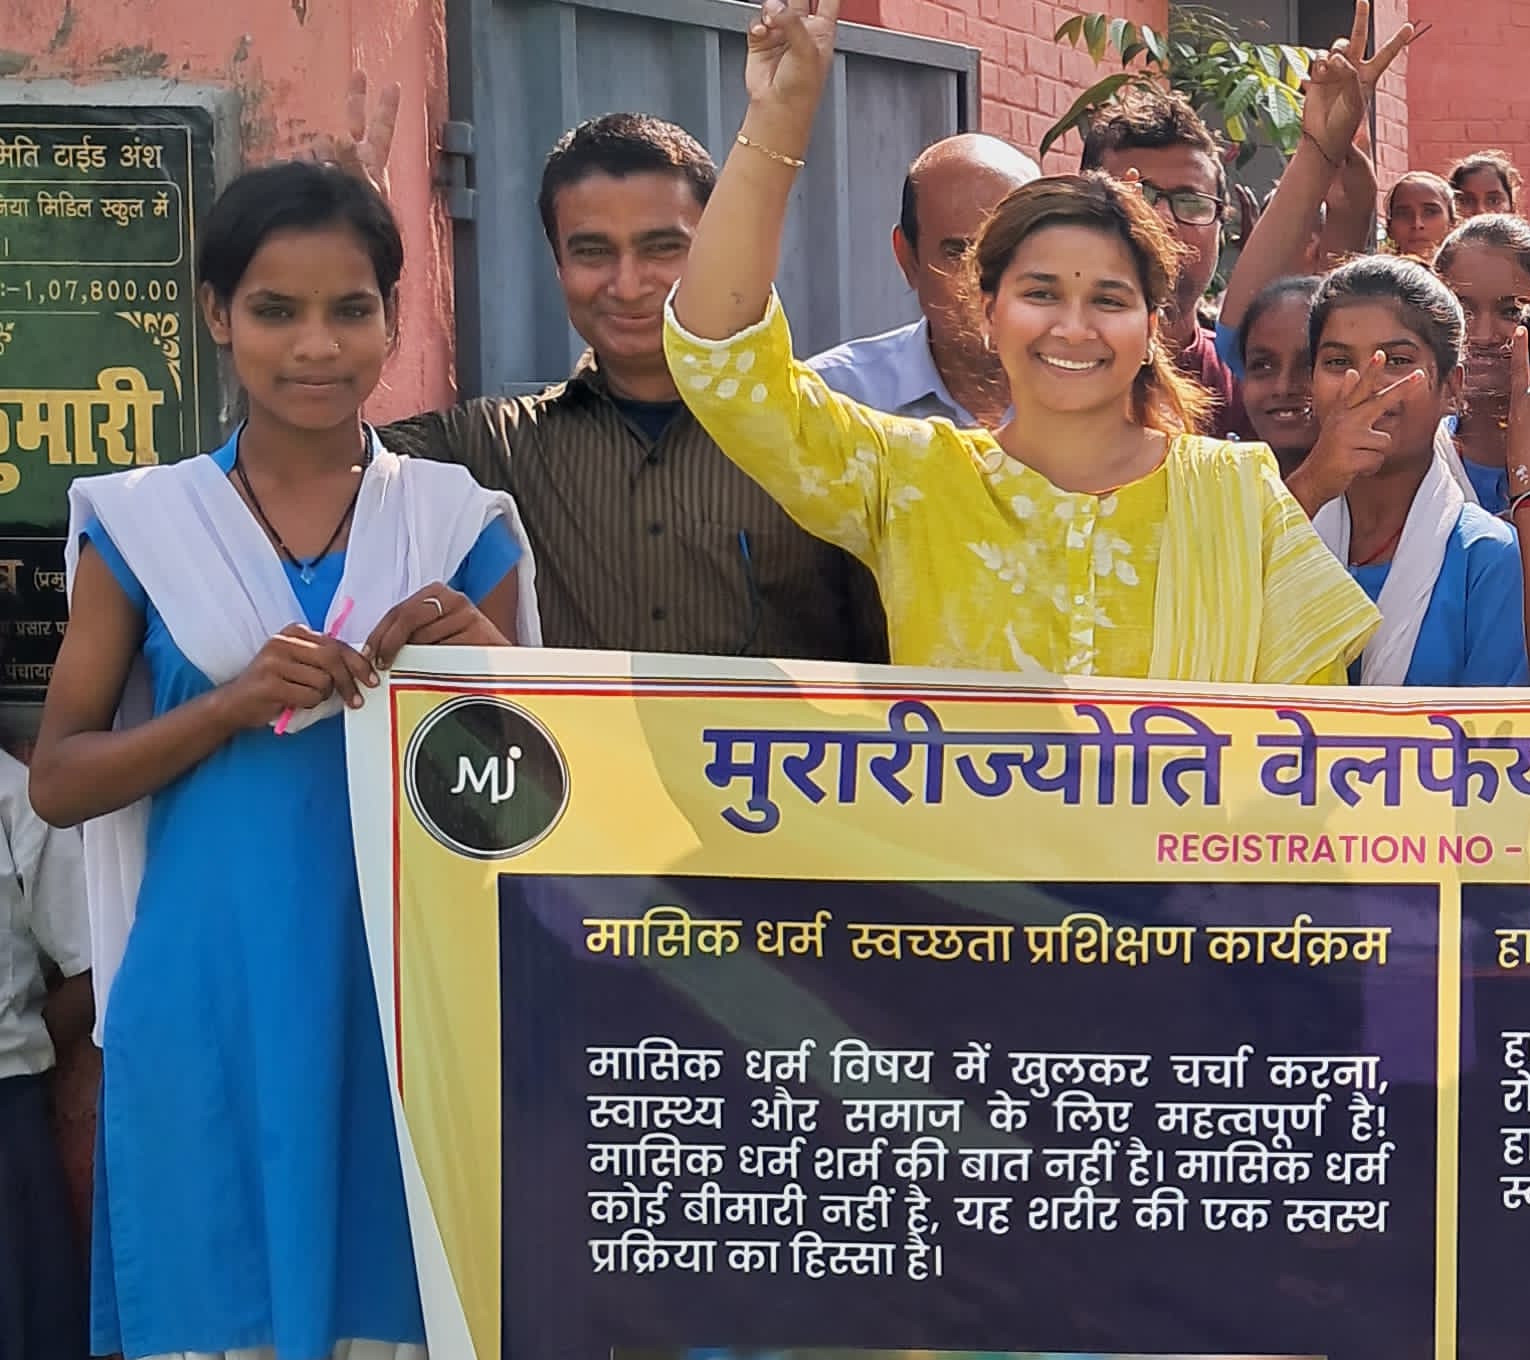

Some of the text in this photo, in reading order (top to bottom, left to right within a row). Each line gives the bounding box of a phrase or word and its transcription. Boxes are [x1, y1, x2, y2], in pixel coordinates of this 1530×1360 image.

[53, 136, 107, 173] टाईड
[119, 137, 163, 169] अंश
[37, 191, 93, 218] मिडिल
[152, 192, 170, 218] में
[702, 700, 1232, 835] मुरारीज्योति
[1157, 834, 1427, 865] REGISTRATION
[1439, 835, 1493, 865] NO
[583, 906, 1392, 967] मासिक धर्म स्वच्छता प्रशिक्षण कार्यक्रम
[586, 1037, 1389, 1097] मासिक धर्म विषय में खुलकर चर्चा करना,
[587, 1095, 725, 1129] स्वास्थ्य
[750, 1087, 820, 1132] और
[842, 1100, 964, 1133] समाज
[987, 1090, 1030, 1131] के
[1052, 1090, 1133, 1133] लिए
[1155, 1094, 1332, 1148] महत्वपूर्ण
[587, 1133, 726, 1176] मासिक
[739, 1137, 807, 1179] धर्म
[814, 1138, 888, 1180] शर्म
[892, 1137, 949, 1182] की
[960, 1146, 1033, 1182] बात
[1042, 1138, 1121, 1185] नहीं
[1176, 1140, 1313, 1185] मासिक
[1325, 1142, 1395, 1185] धर्म
[588, 1181, 1390, 1234] कोई बीमारी नहीं है, यह शरीर की एक स्वस्थ
[588, 1229, 718, 1274] प्रक्रिया
[725, 1241, 781, 1273] का
[789, 1231, 896, 1278] हिस्सा
